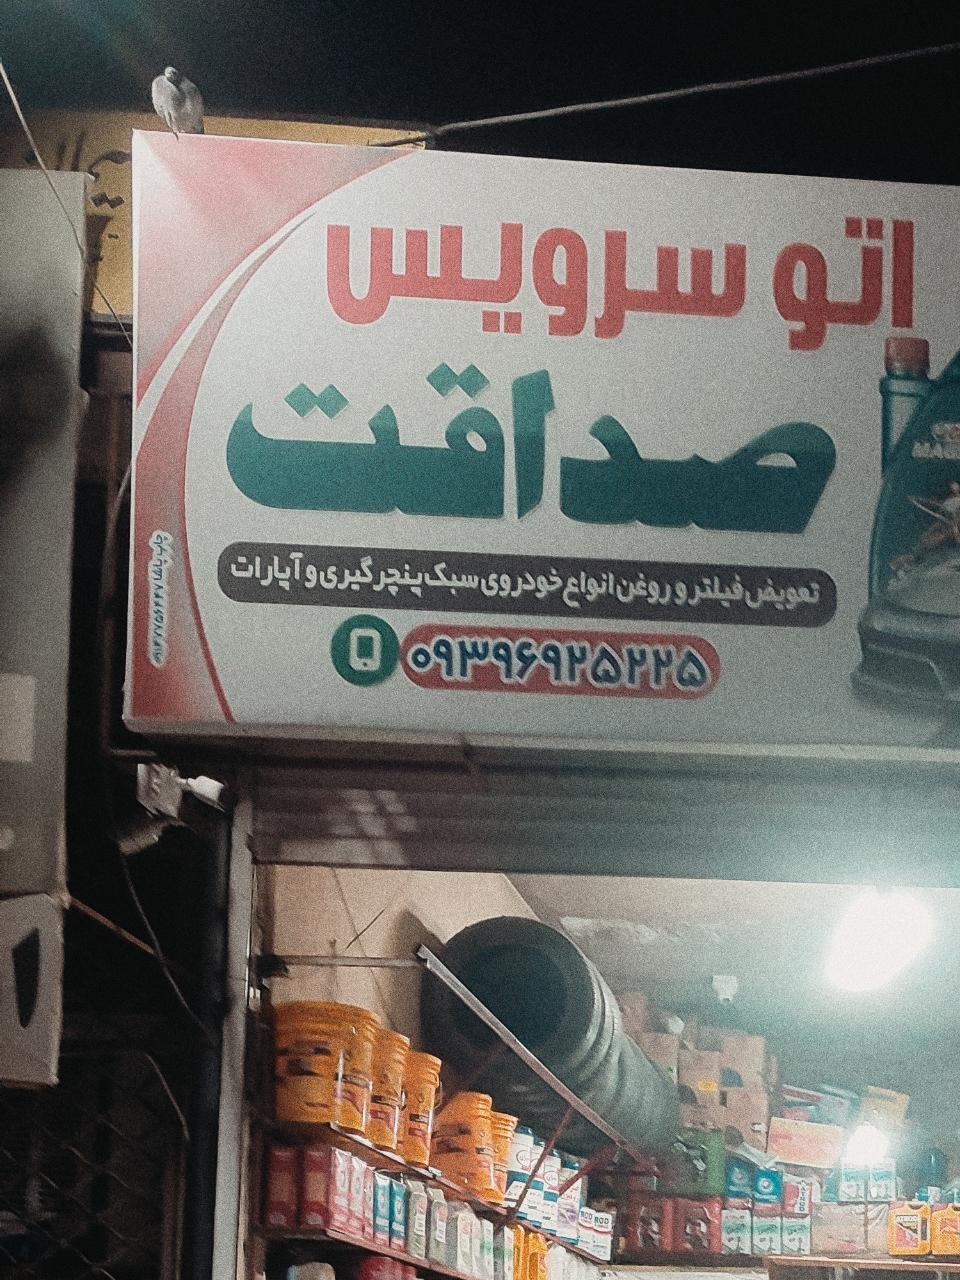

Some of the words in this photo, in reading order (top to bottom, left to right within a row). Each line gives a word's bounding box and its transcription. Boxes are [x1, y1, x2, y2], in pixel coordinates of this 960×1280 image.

[326, 221, 748, 339] سرویس
[774, 216, 916, 352] اتو
[226, 361, 839, 535] صداقت
[230, 551, 304, 592] آپارات
[303, 564, 318, 588] و
[424, 561, 479, 596] سبک
[479, 566, 564, 600] خودروی
[562, 570, 615, 609] انواع
[617, 571, 671, 606] روغن
[674, 581, 689, 606] و
[688, 573, 744, 609] فیلتر
[744, 577, 820, 611] تعویض
[409, 635, 711, 690] ۰۹۳۹۶۹۲۵۲۲۵
